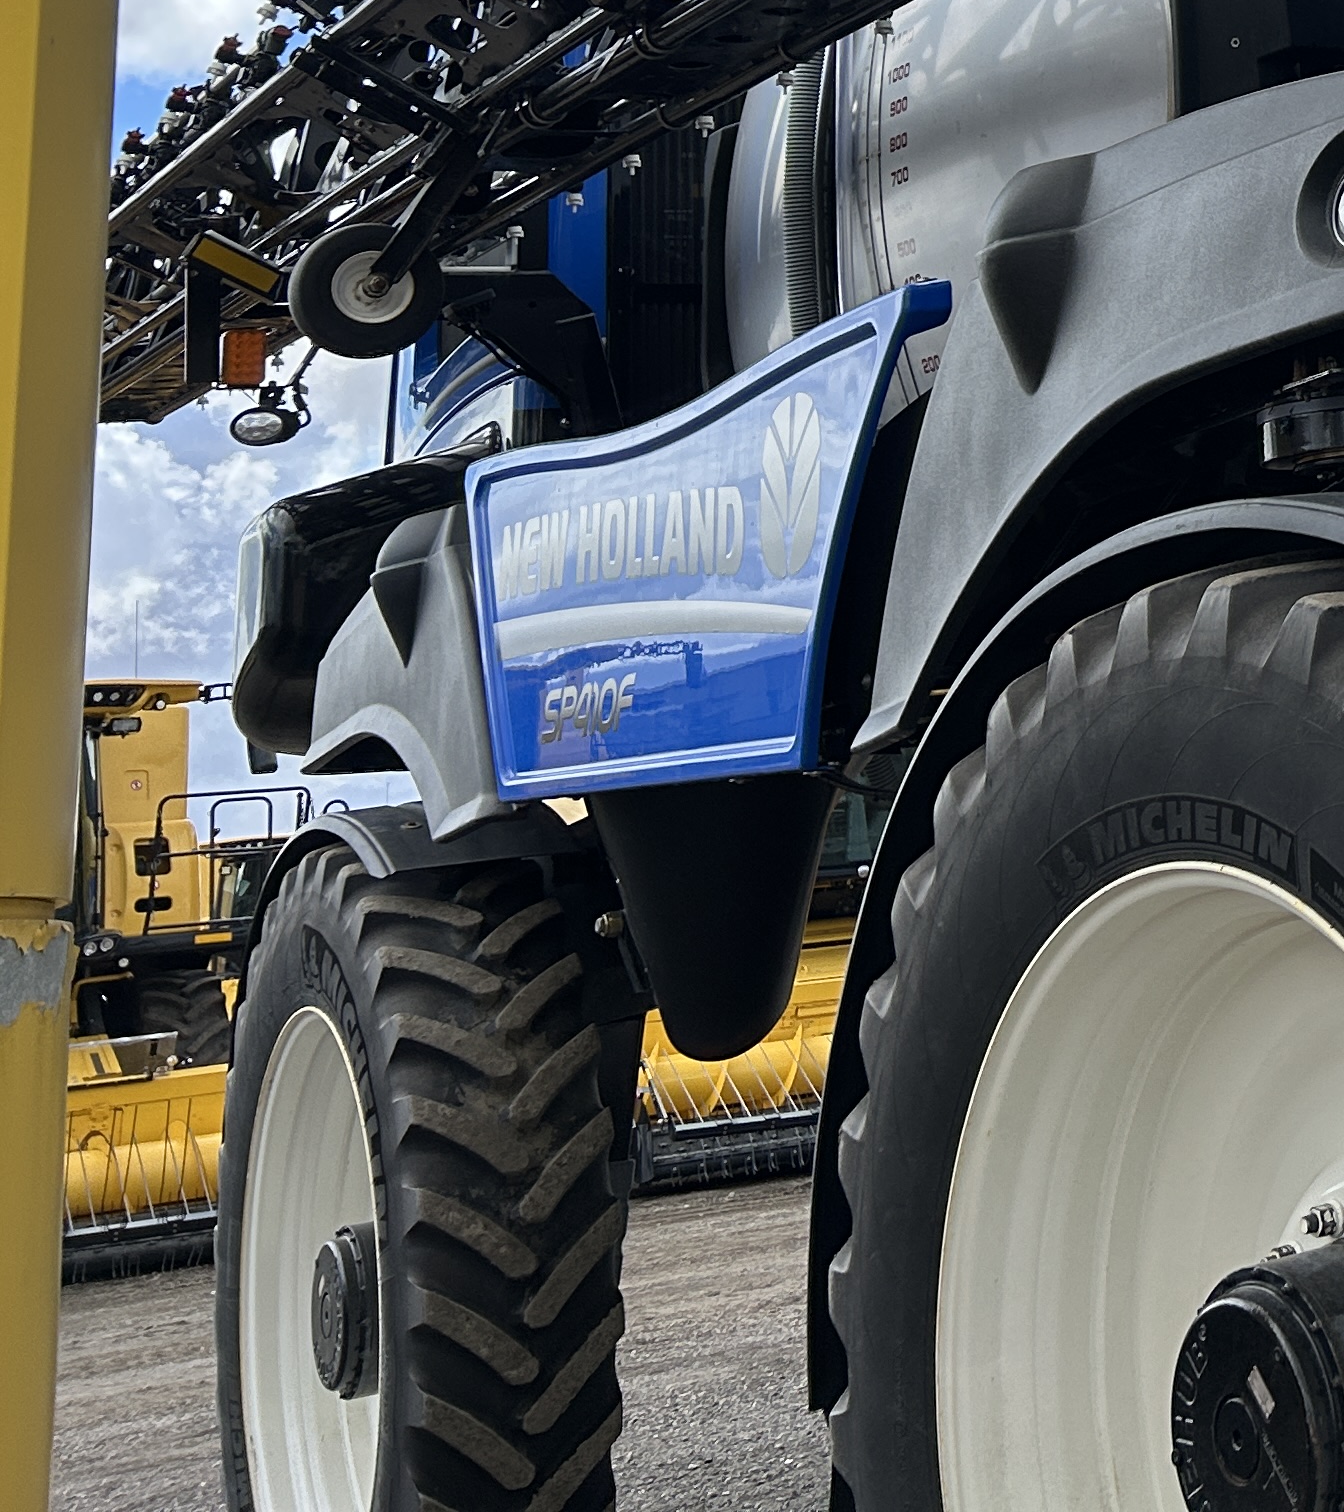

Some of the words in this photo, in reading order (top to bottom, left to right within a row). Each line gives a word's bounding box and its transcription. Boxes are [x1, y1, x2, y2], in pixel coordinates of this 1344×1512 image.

[888, 62, 910, 85] 1000
[890, 96, 908, 117] 900
[890, 132, 908, 153] 800
[891, 166, 909, 188] 700
[897, 238, 917, 257] 500
[921, 355, 941, 374] 200
[501, 509, 569, 600] NEW
[577, 486, 744, 583] HOLLAND
[541, 673, 636, 743] SP410F
[1088, 800, 1294, 871] MICHELIN
